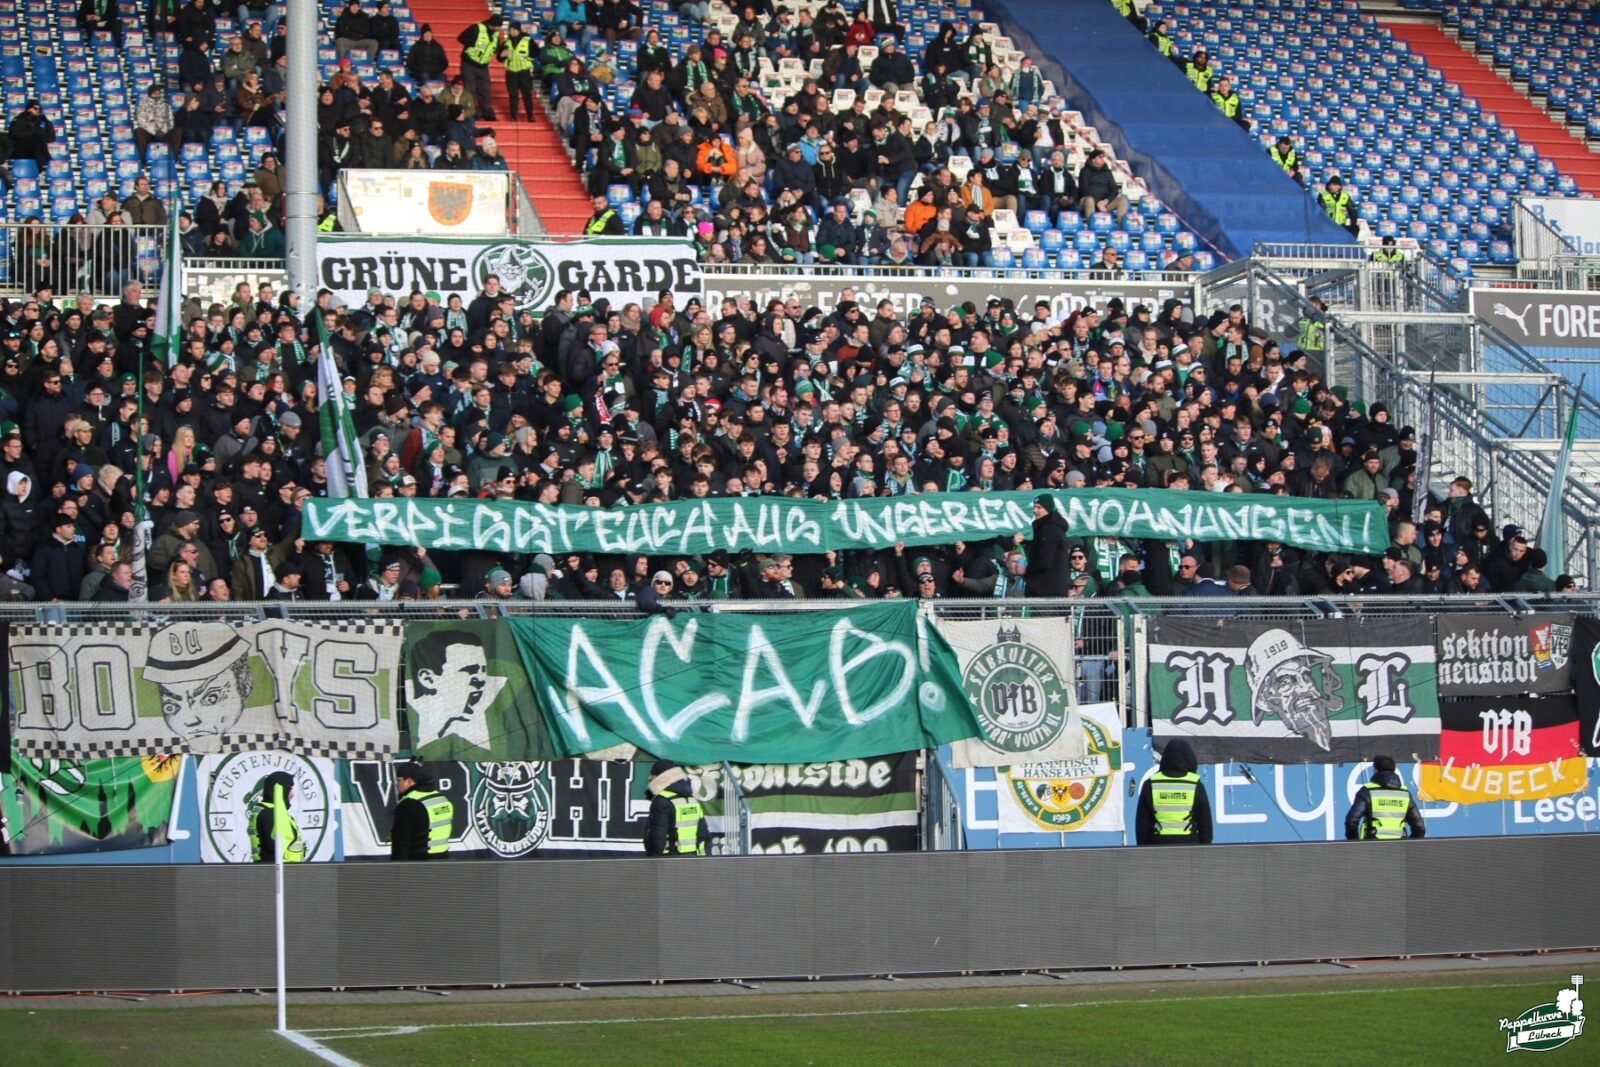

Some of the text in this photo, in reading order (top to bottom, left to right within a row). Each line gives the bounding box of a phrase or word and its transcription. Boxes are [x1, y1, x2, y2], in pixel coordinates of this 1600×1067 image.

[322, 252, 700, 293] GRÜNE GARDE
[593, 501, 718, 553] EUCH
[723, 502, 820, 547] AUS
[169, 628, 202, 656] BU
[1264, 639, 1288, 660] 1919
[969, 646, 1055, 686] SUBKULTUR
[1438, 656, 1539, 685] neustadt
[217, 753, 317, 801] KÜSTENJUNGS
[1024, 766, 1096, 778] HANSEATEN
[1442, 756, 1565, 796] LÜBECK
[1052, 813, 1071, 823] 1919
